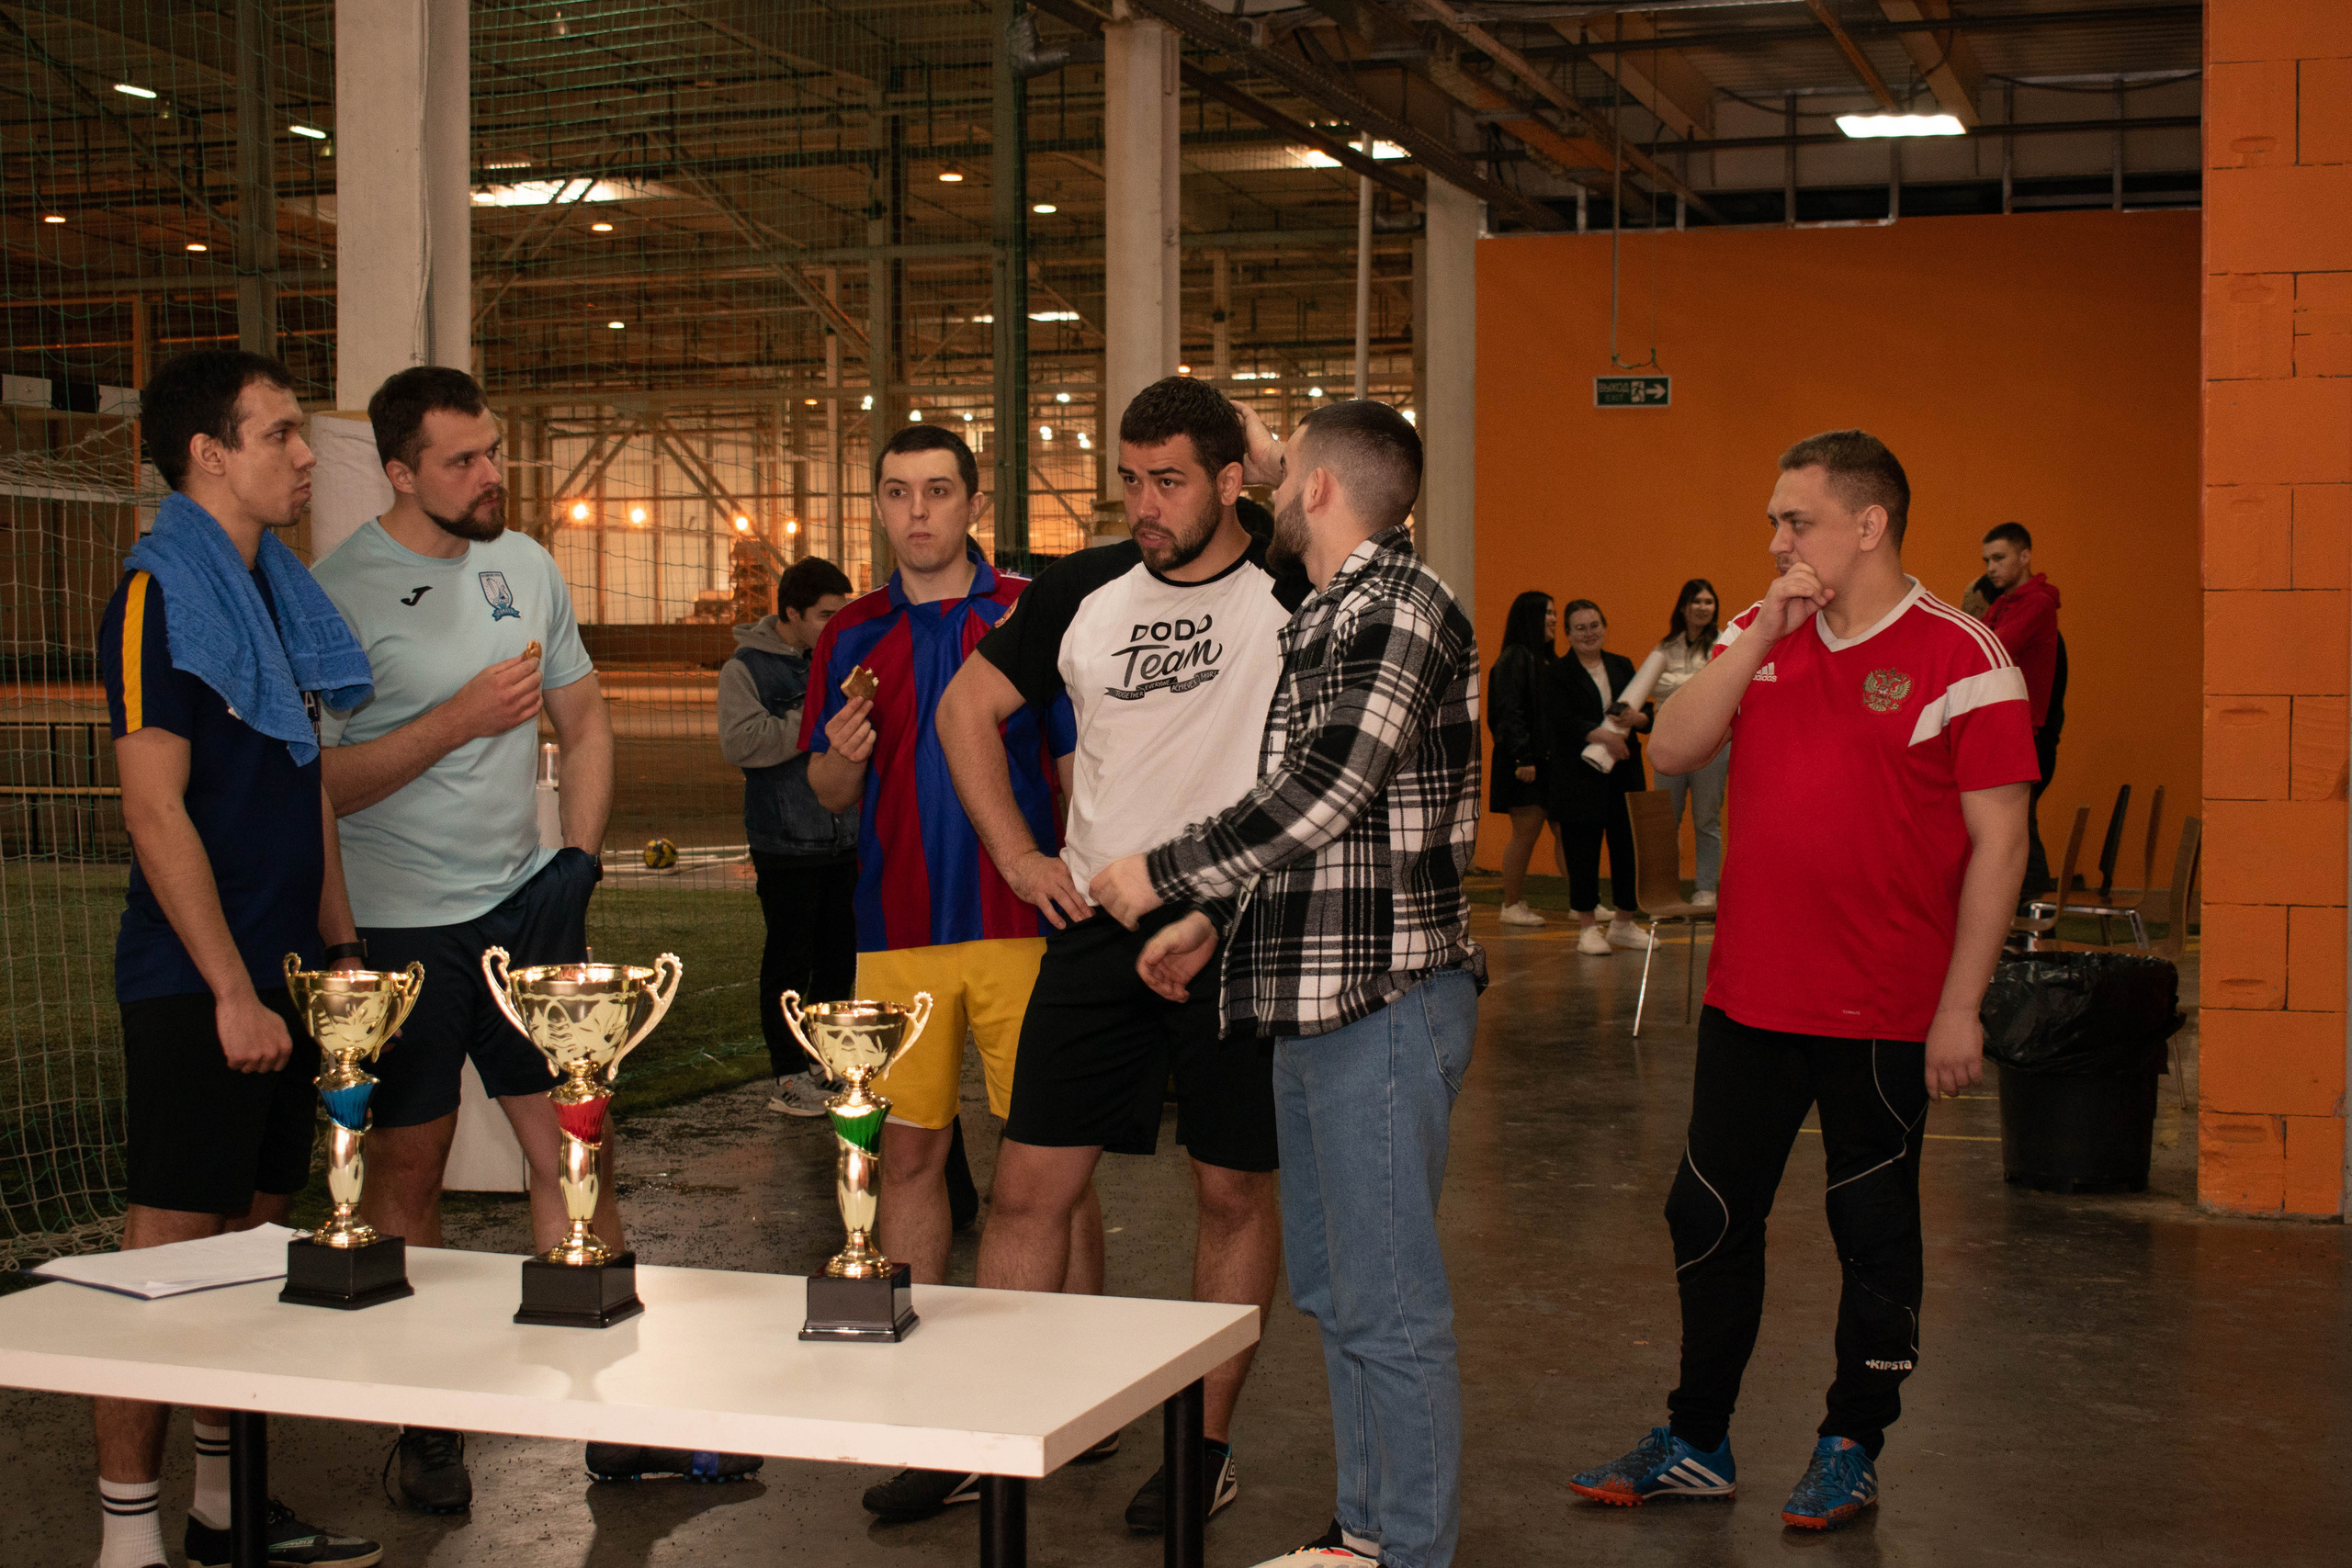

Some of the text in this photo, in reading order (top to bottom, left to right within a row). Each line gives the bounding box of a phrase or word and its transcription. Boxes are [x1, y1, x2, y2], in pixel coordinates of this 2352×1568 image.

[1111, 638, 1223, 688] Team
[1115, 689, 1145, 700] TOGETHER
[1145, 679, 1170, 691] EVERYONE
[1171, 679, 1198, 692] ACHIEVES
